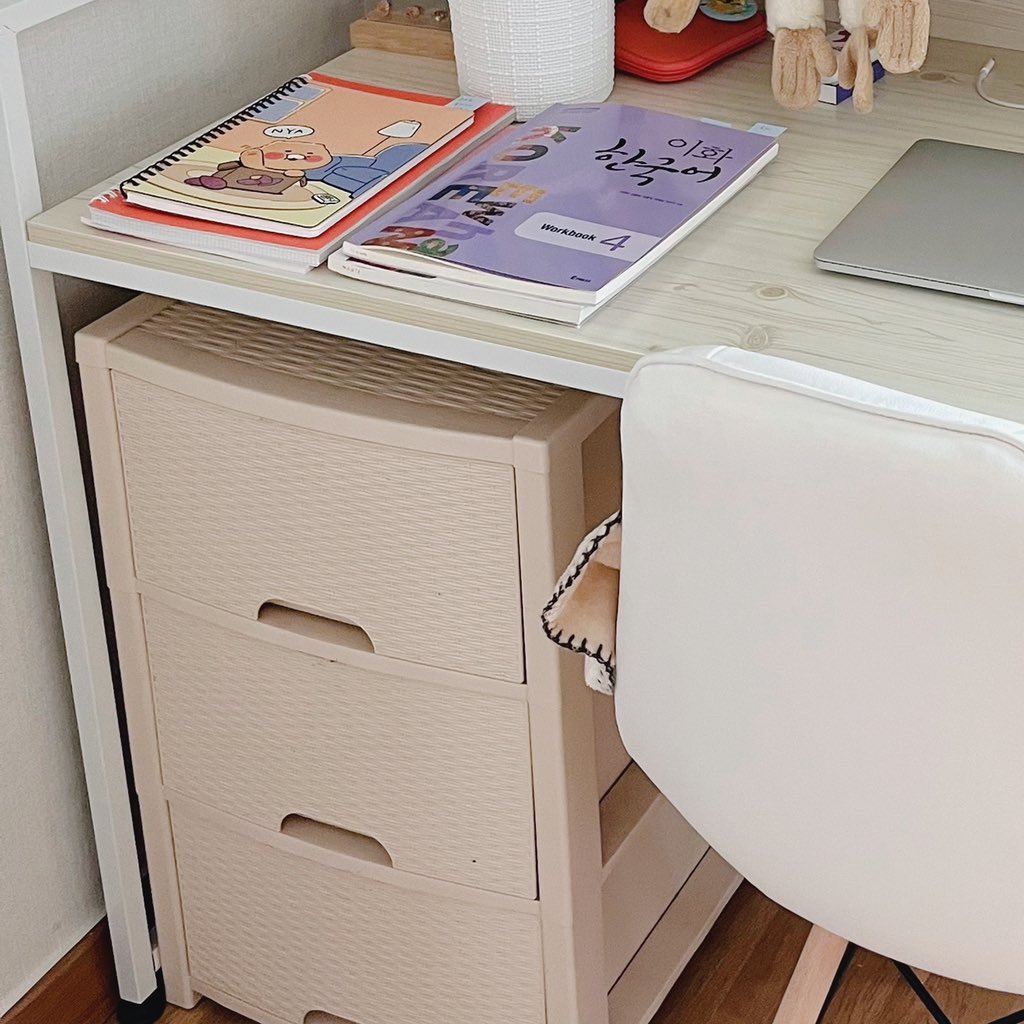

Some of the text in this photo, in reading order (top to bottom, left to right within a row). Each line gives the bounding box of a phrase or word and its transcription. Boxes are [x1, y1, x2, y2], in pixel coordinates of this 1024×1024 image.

[594, 137, 722, 187] 한국어
[668, 138, 733, 165] 이화
[540, 223, 632, 252] Workbook 4
